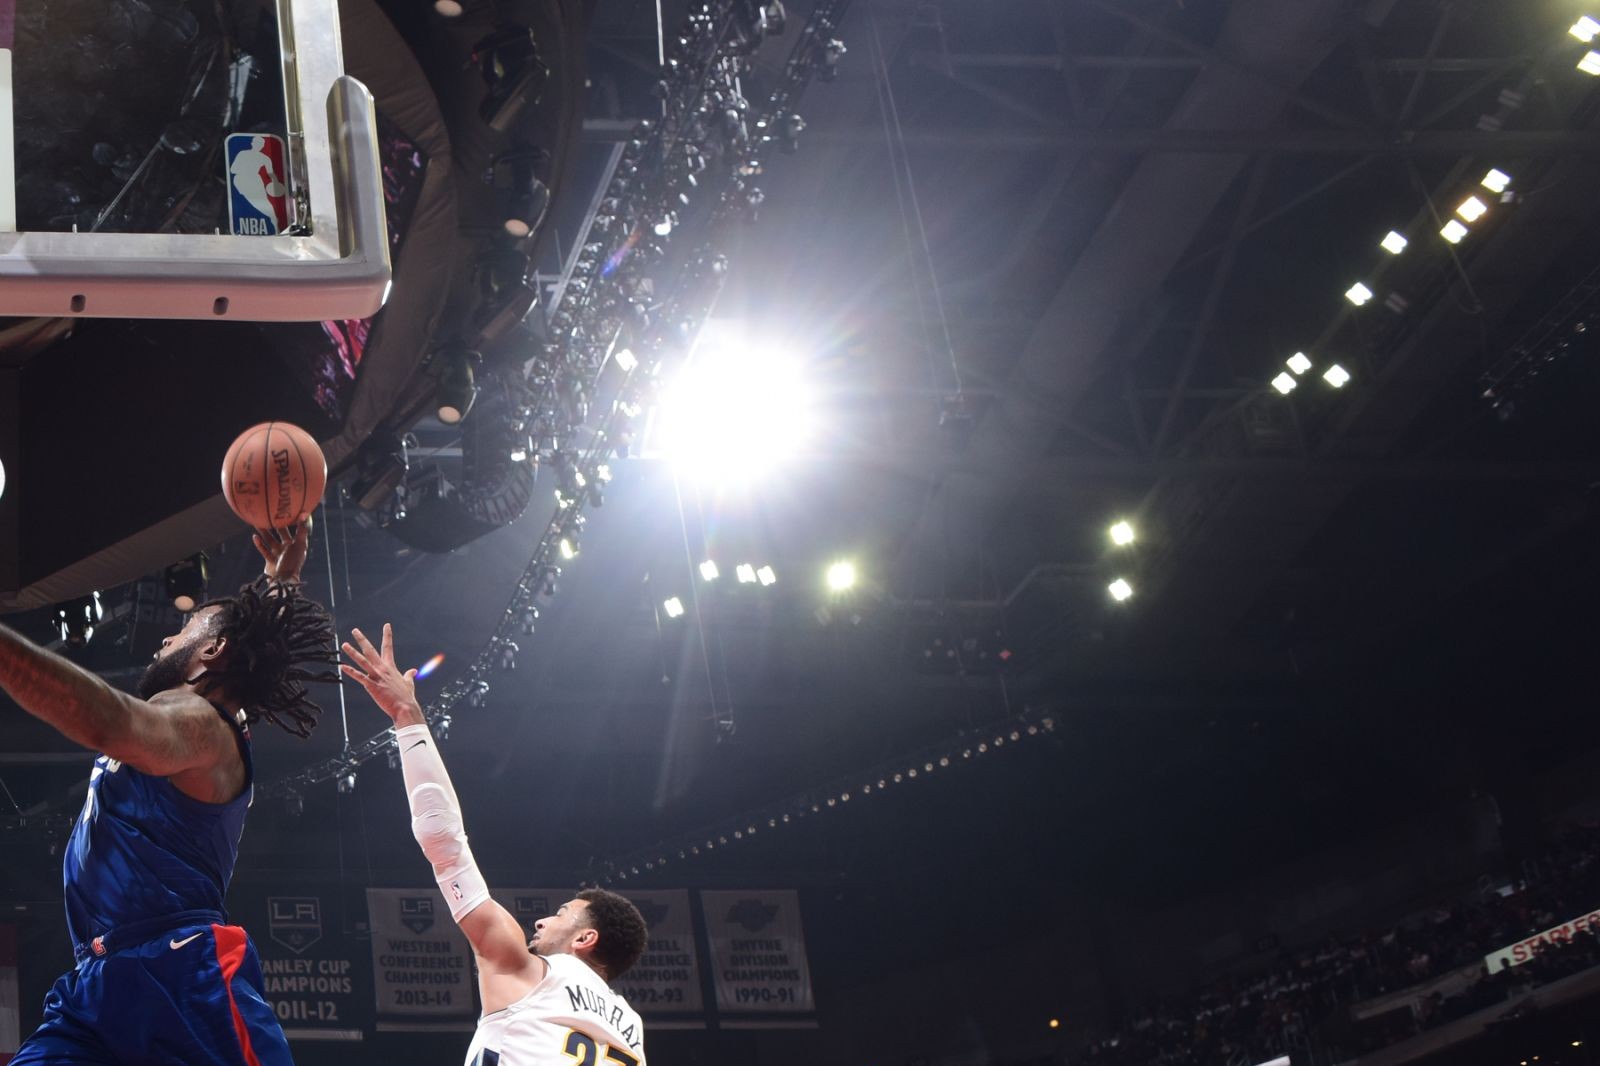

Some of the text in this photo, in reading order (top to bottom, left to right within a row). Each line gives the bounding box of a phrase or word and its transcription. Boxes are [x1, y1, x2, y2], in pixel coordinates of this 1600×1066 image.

[239, 217, 268, 235] NBA
[388, 941, 451, 953] WESTERN
[319, 960, 351, 975] CUP
[379, 954, 463, 969] CONFERENCE
[384, 970, 460, 985] CHAMPIONS
[724, 969, 800, 982] CHAMPIONS
[396, 989, 450, 1006] 2013-14
[564, 984, 641, 1049] MURRAY
